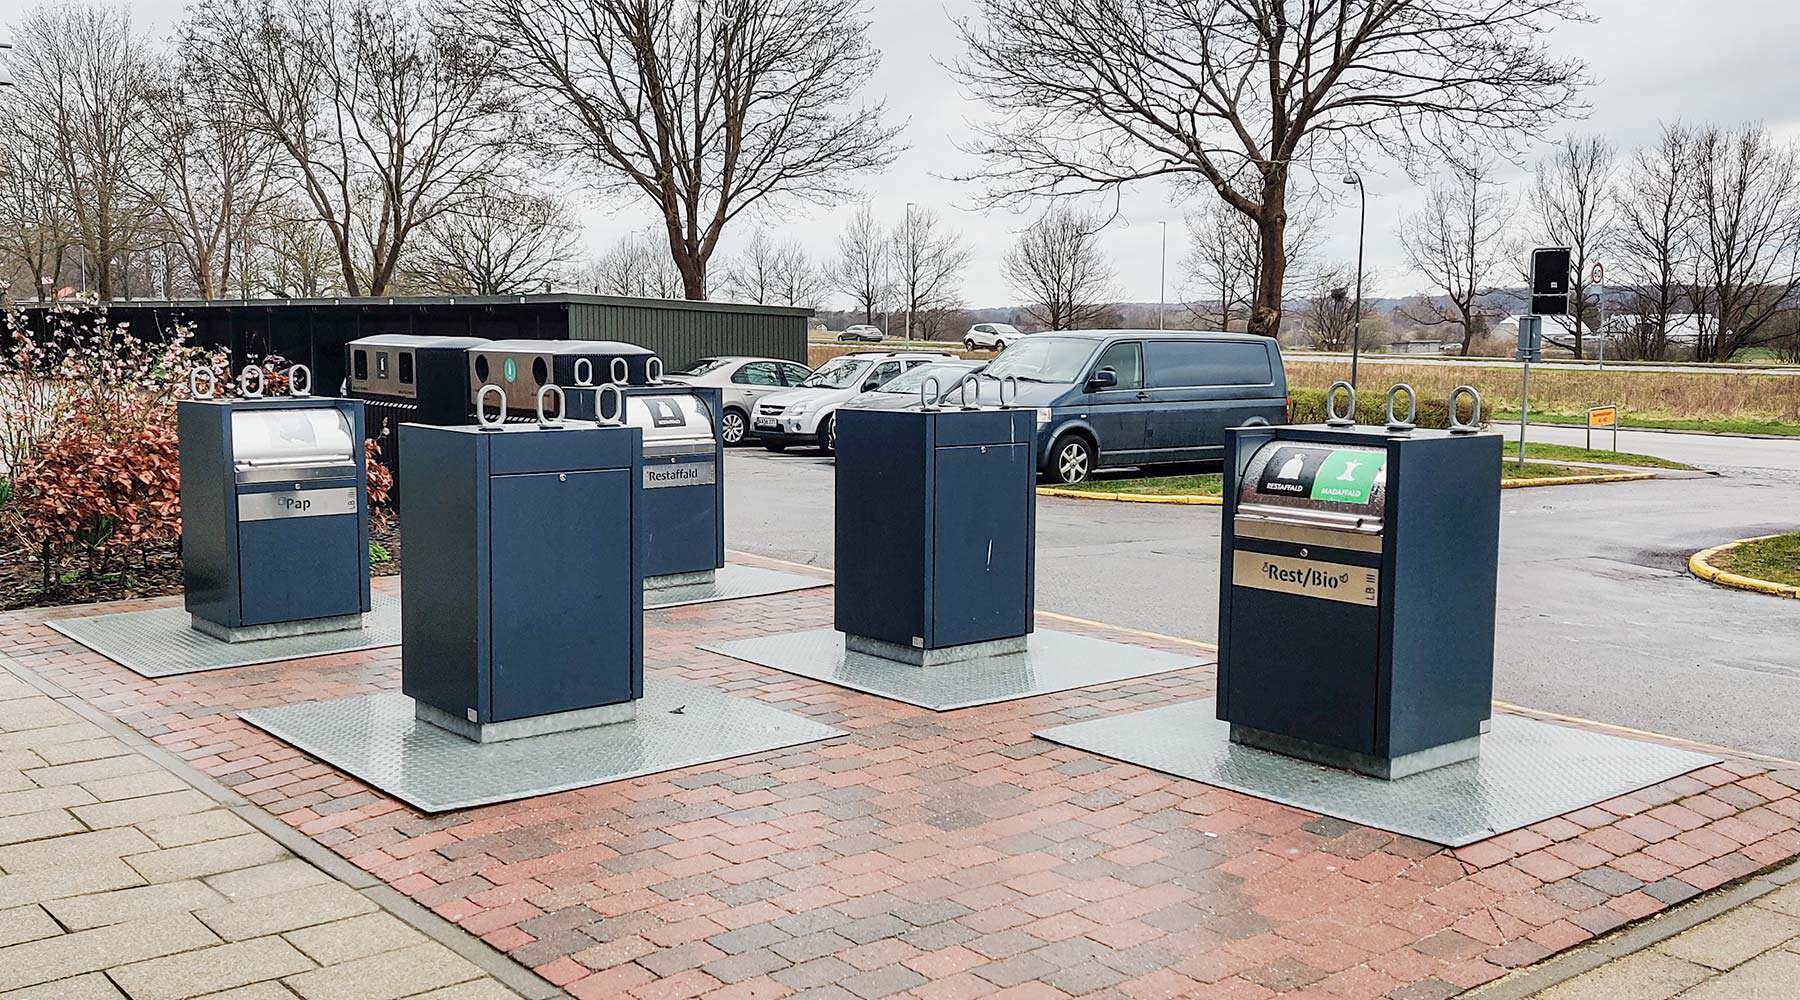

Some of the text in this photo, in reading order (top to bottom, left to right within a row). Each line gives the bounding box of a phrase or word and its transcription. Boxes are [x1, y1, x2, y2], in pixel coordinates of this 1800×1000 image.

[649, 468, 698, 481] Restaffald
[1266, 482, 1303, 492] RESTAFFALD
[1321, 487, 1361, 497] MADAFFALD
[286, 498, 311, 511] Pap
[1268, 564, 1338, 589] Rest/Bio
[1365, 586, 1376, 601] LB
